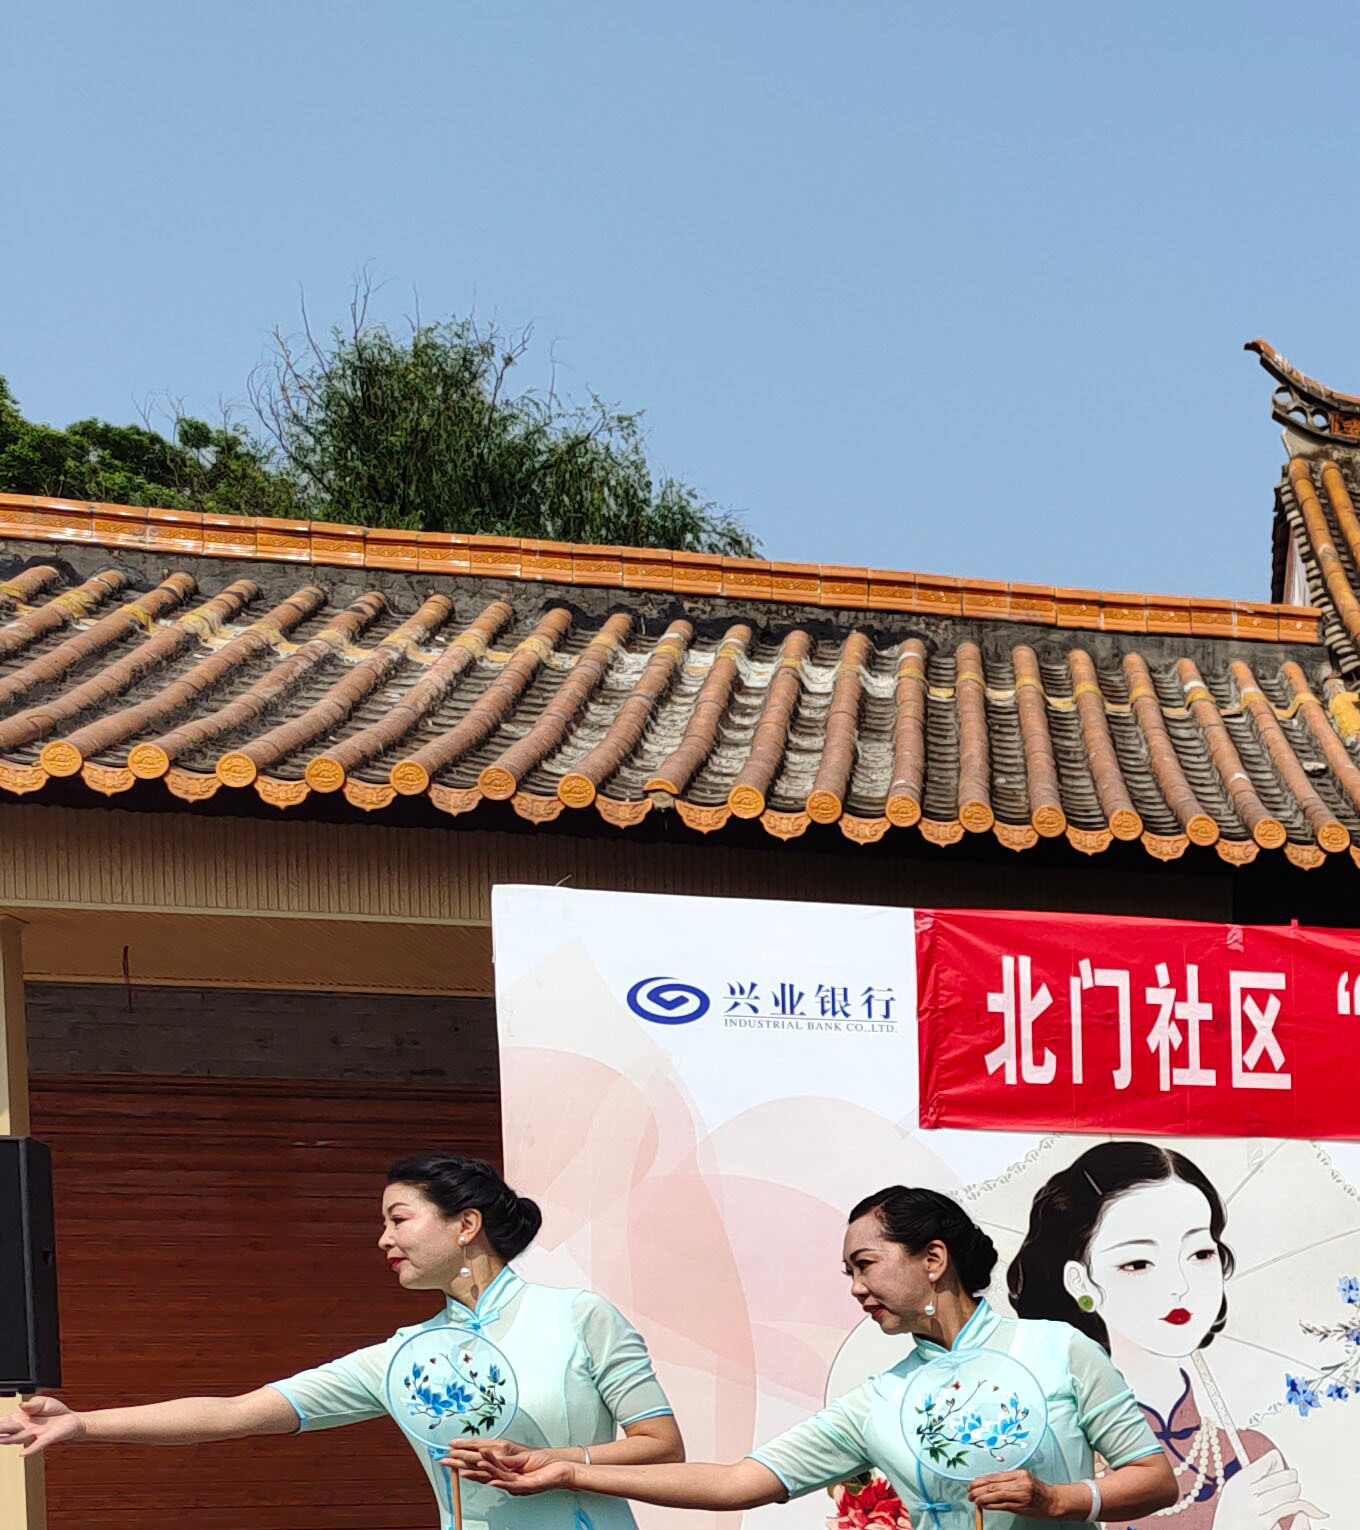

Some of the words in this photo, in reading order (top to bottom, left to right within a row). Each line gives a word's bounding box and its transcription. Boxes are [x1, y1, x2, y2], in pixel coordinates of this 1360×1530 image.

[722, 981, 897, 1019] 兴业银行
[724, 1018, 803, 1030] INDUSTRIAL
[807, 1021, 842, 1032] BANK
[983, 953, 1293, 1092] 北门社区
